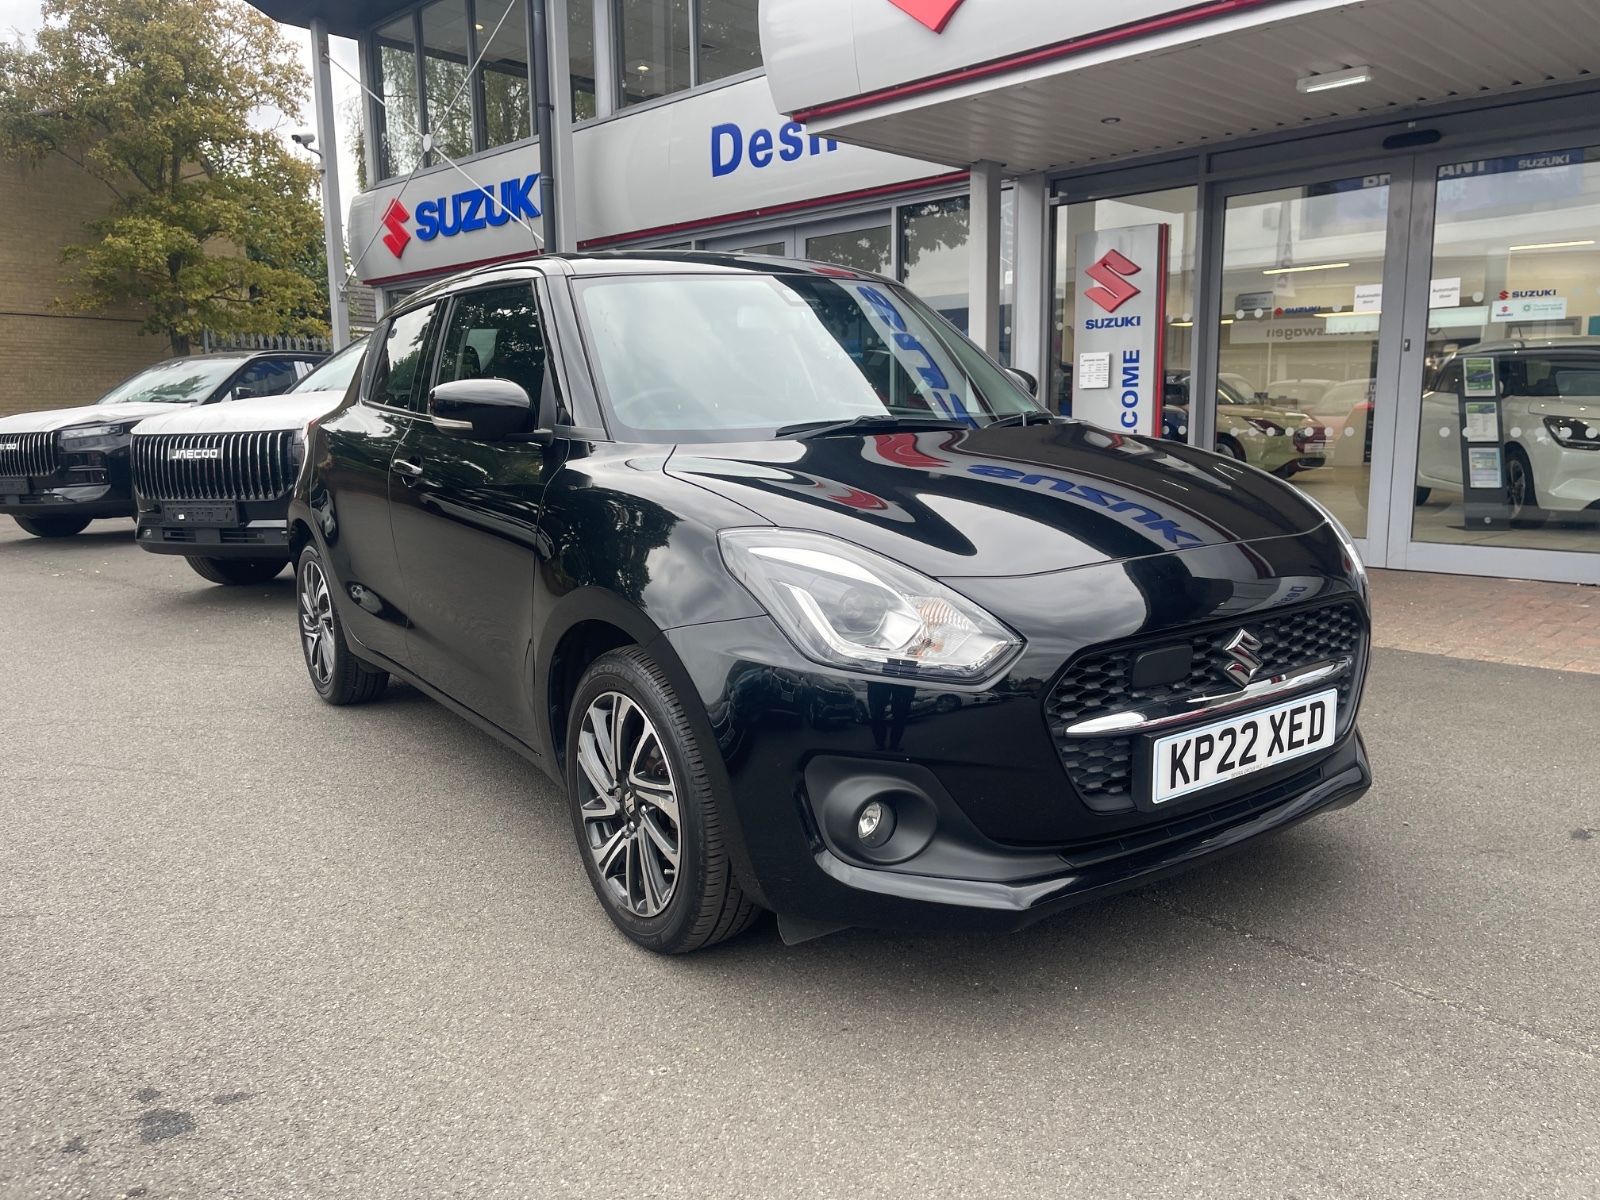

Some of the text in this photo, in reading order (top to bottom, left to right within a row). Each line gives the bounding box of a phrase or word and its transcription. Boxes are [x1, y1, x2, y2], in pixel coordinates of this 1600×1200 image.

[1518, 153, 1570, 170] SUZUKI
[415, 172, 542, 242] SUZUK
[1511, 288, 1557, 298] SUZUKI
[1085, 315, 1141, 330] SUZUKI
[1120, 349, 1140, 434] COME
[172, 449, 218, 459] JAECOO
[1169, 700, 1326, 790] KP22 XED
